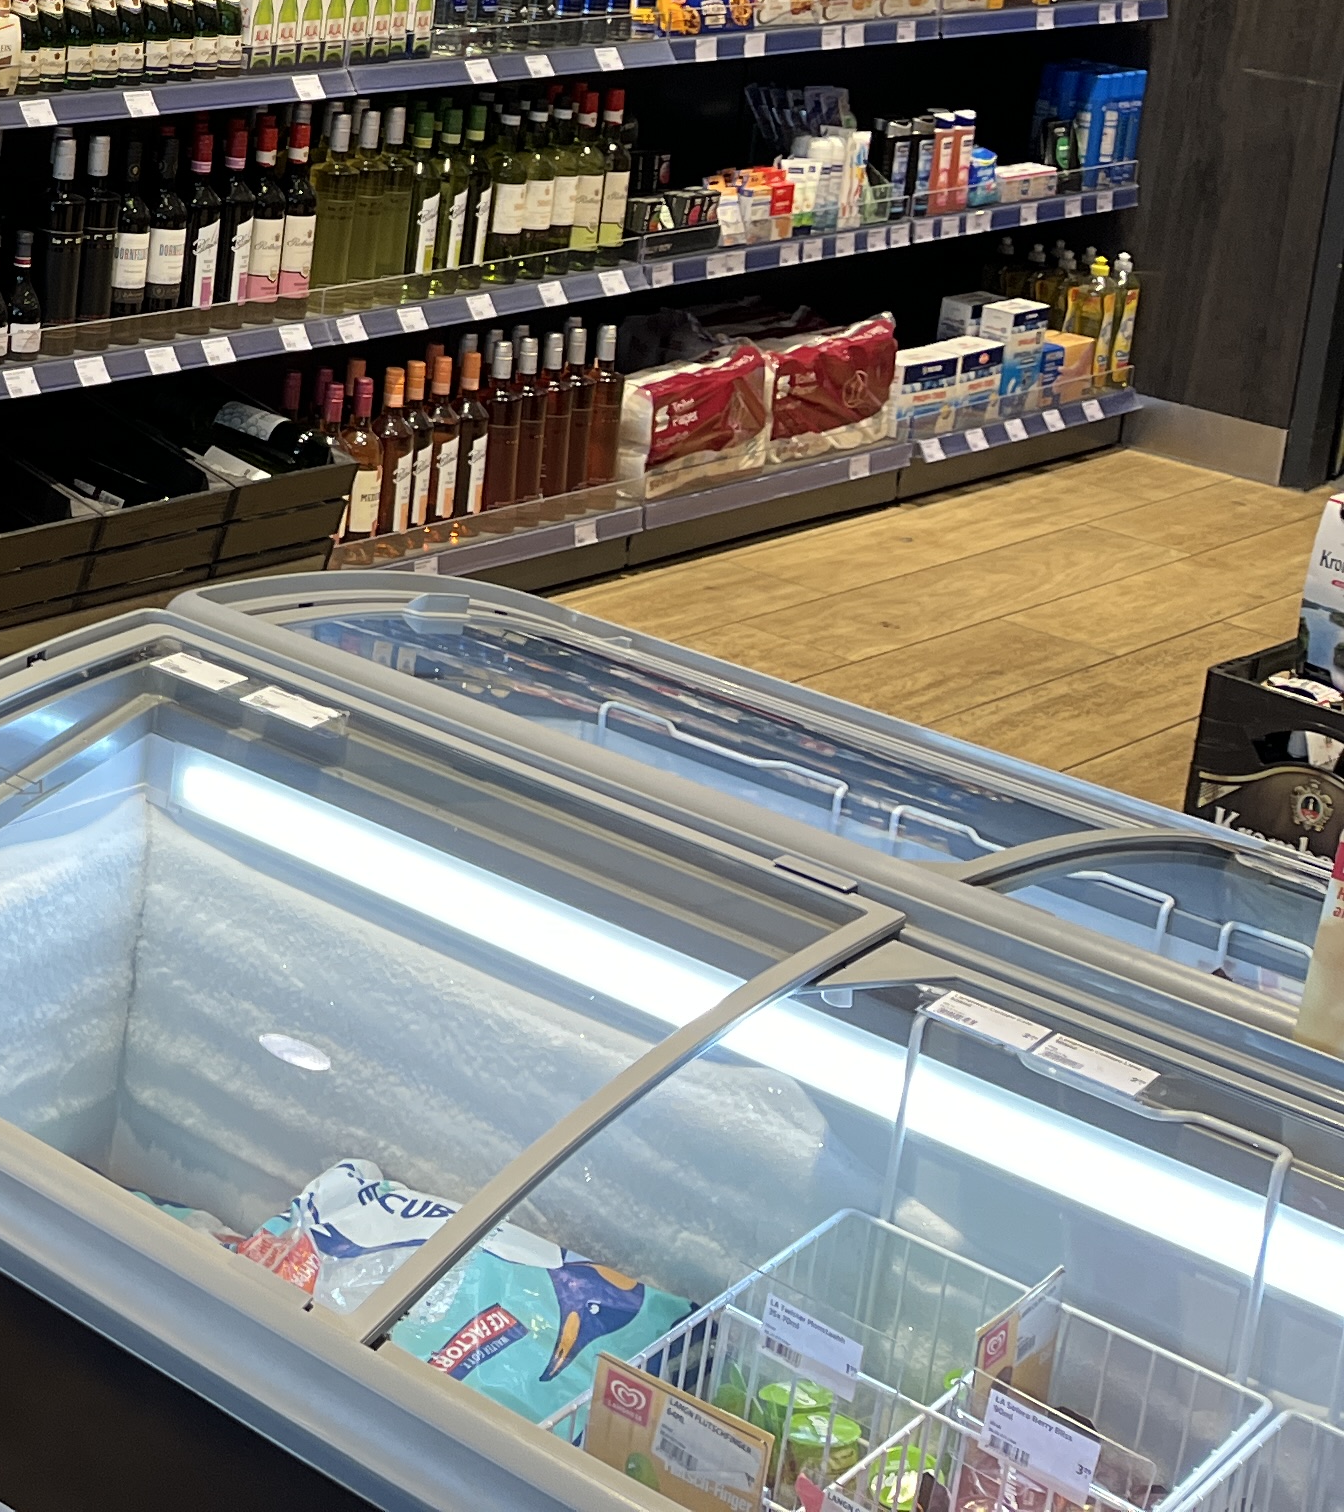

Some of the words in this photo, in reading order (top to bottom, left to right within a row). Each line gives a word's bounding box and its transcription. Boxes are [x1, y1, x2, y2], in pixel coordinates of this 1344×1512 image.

[487, 1311, 510, 1331] ICE
[694, 1413, 752, 1454] FLUTSCHFINGER
[995, 1395, 1005, 1406] LA
[1032, 1414, 1053, 1432] Berry
[1055, 1424, 1072, 1442] Bliss
